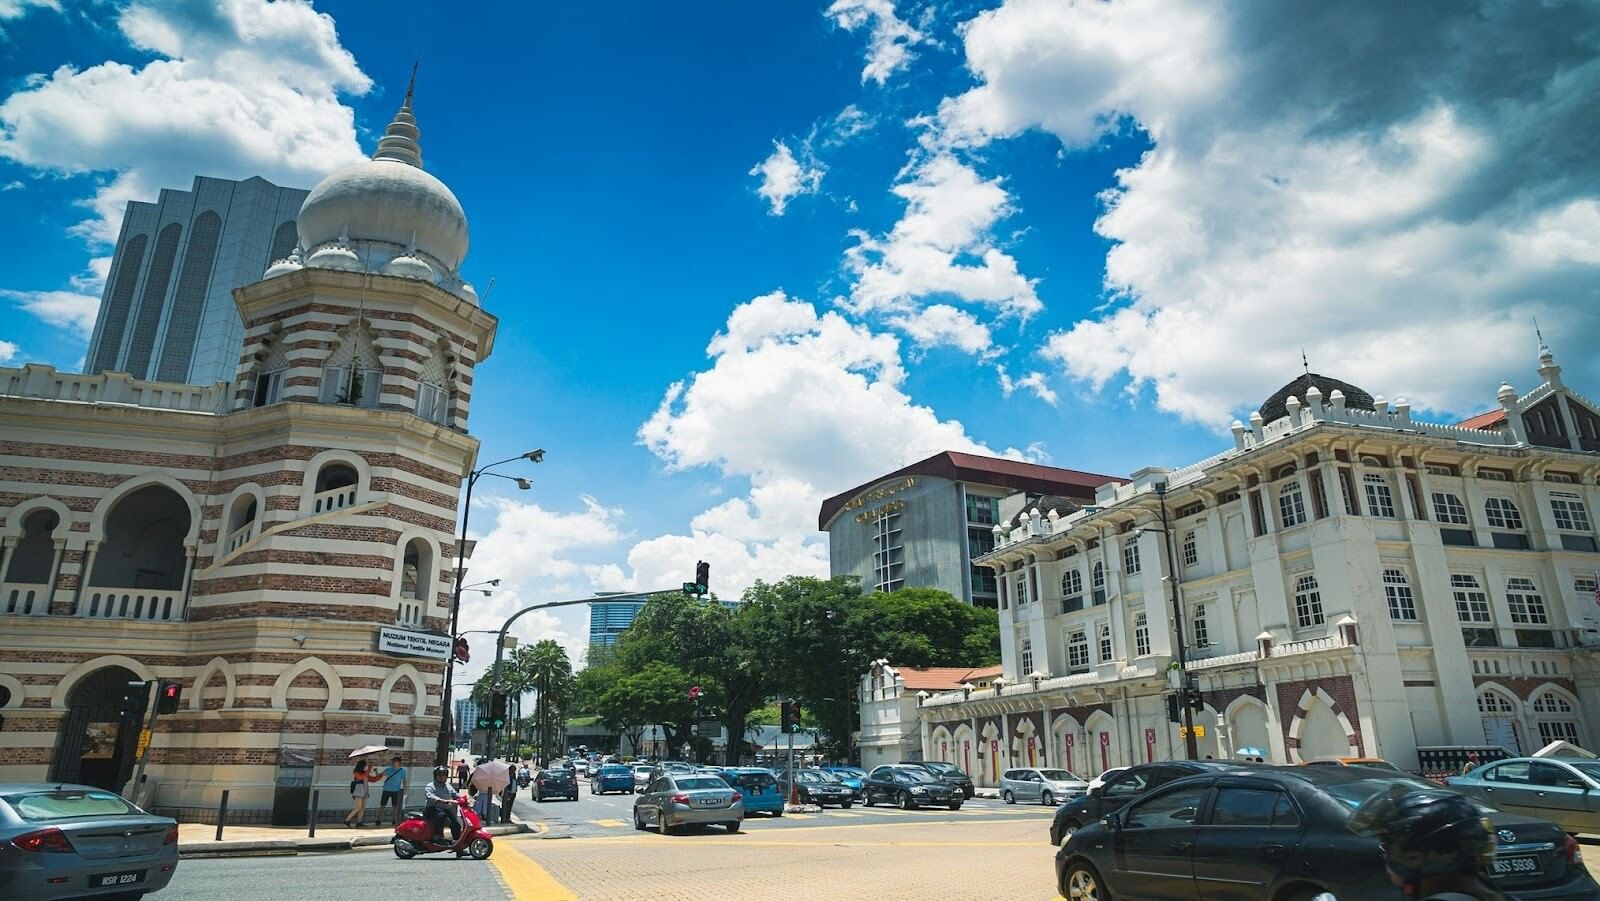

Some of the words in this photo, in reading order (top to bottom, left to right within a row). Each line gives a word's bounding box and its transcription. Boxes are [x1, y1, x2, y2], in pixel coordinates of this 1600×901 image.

[382, 632, 406, 641] MUZIUM
[428, 639, 450, 648] NEGARA
[386, 641, 408, 650] National
[1493, 860, 1512, 872] WSS
[1512, 858, 1536, 872] 5938
[102, 876, 118, 886] WSR
[120, 874, 137, 884] 1224
